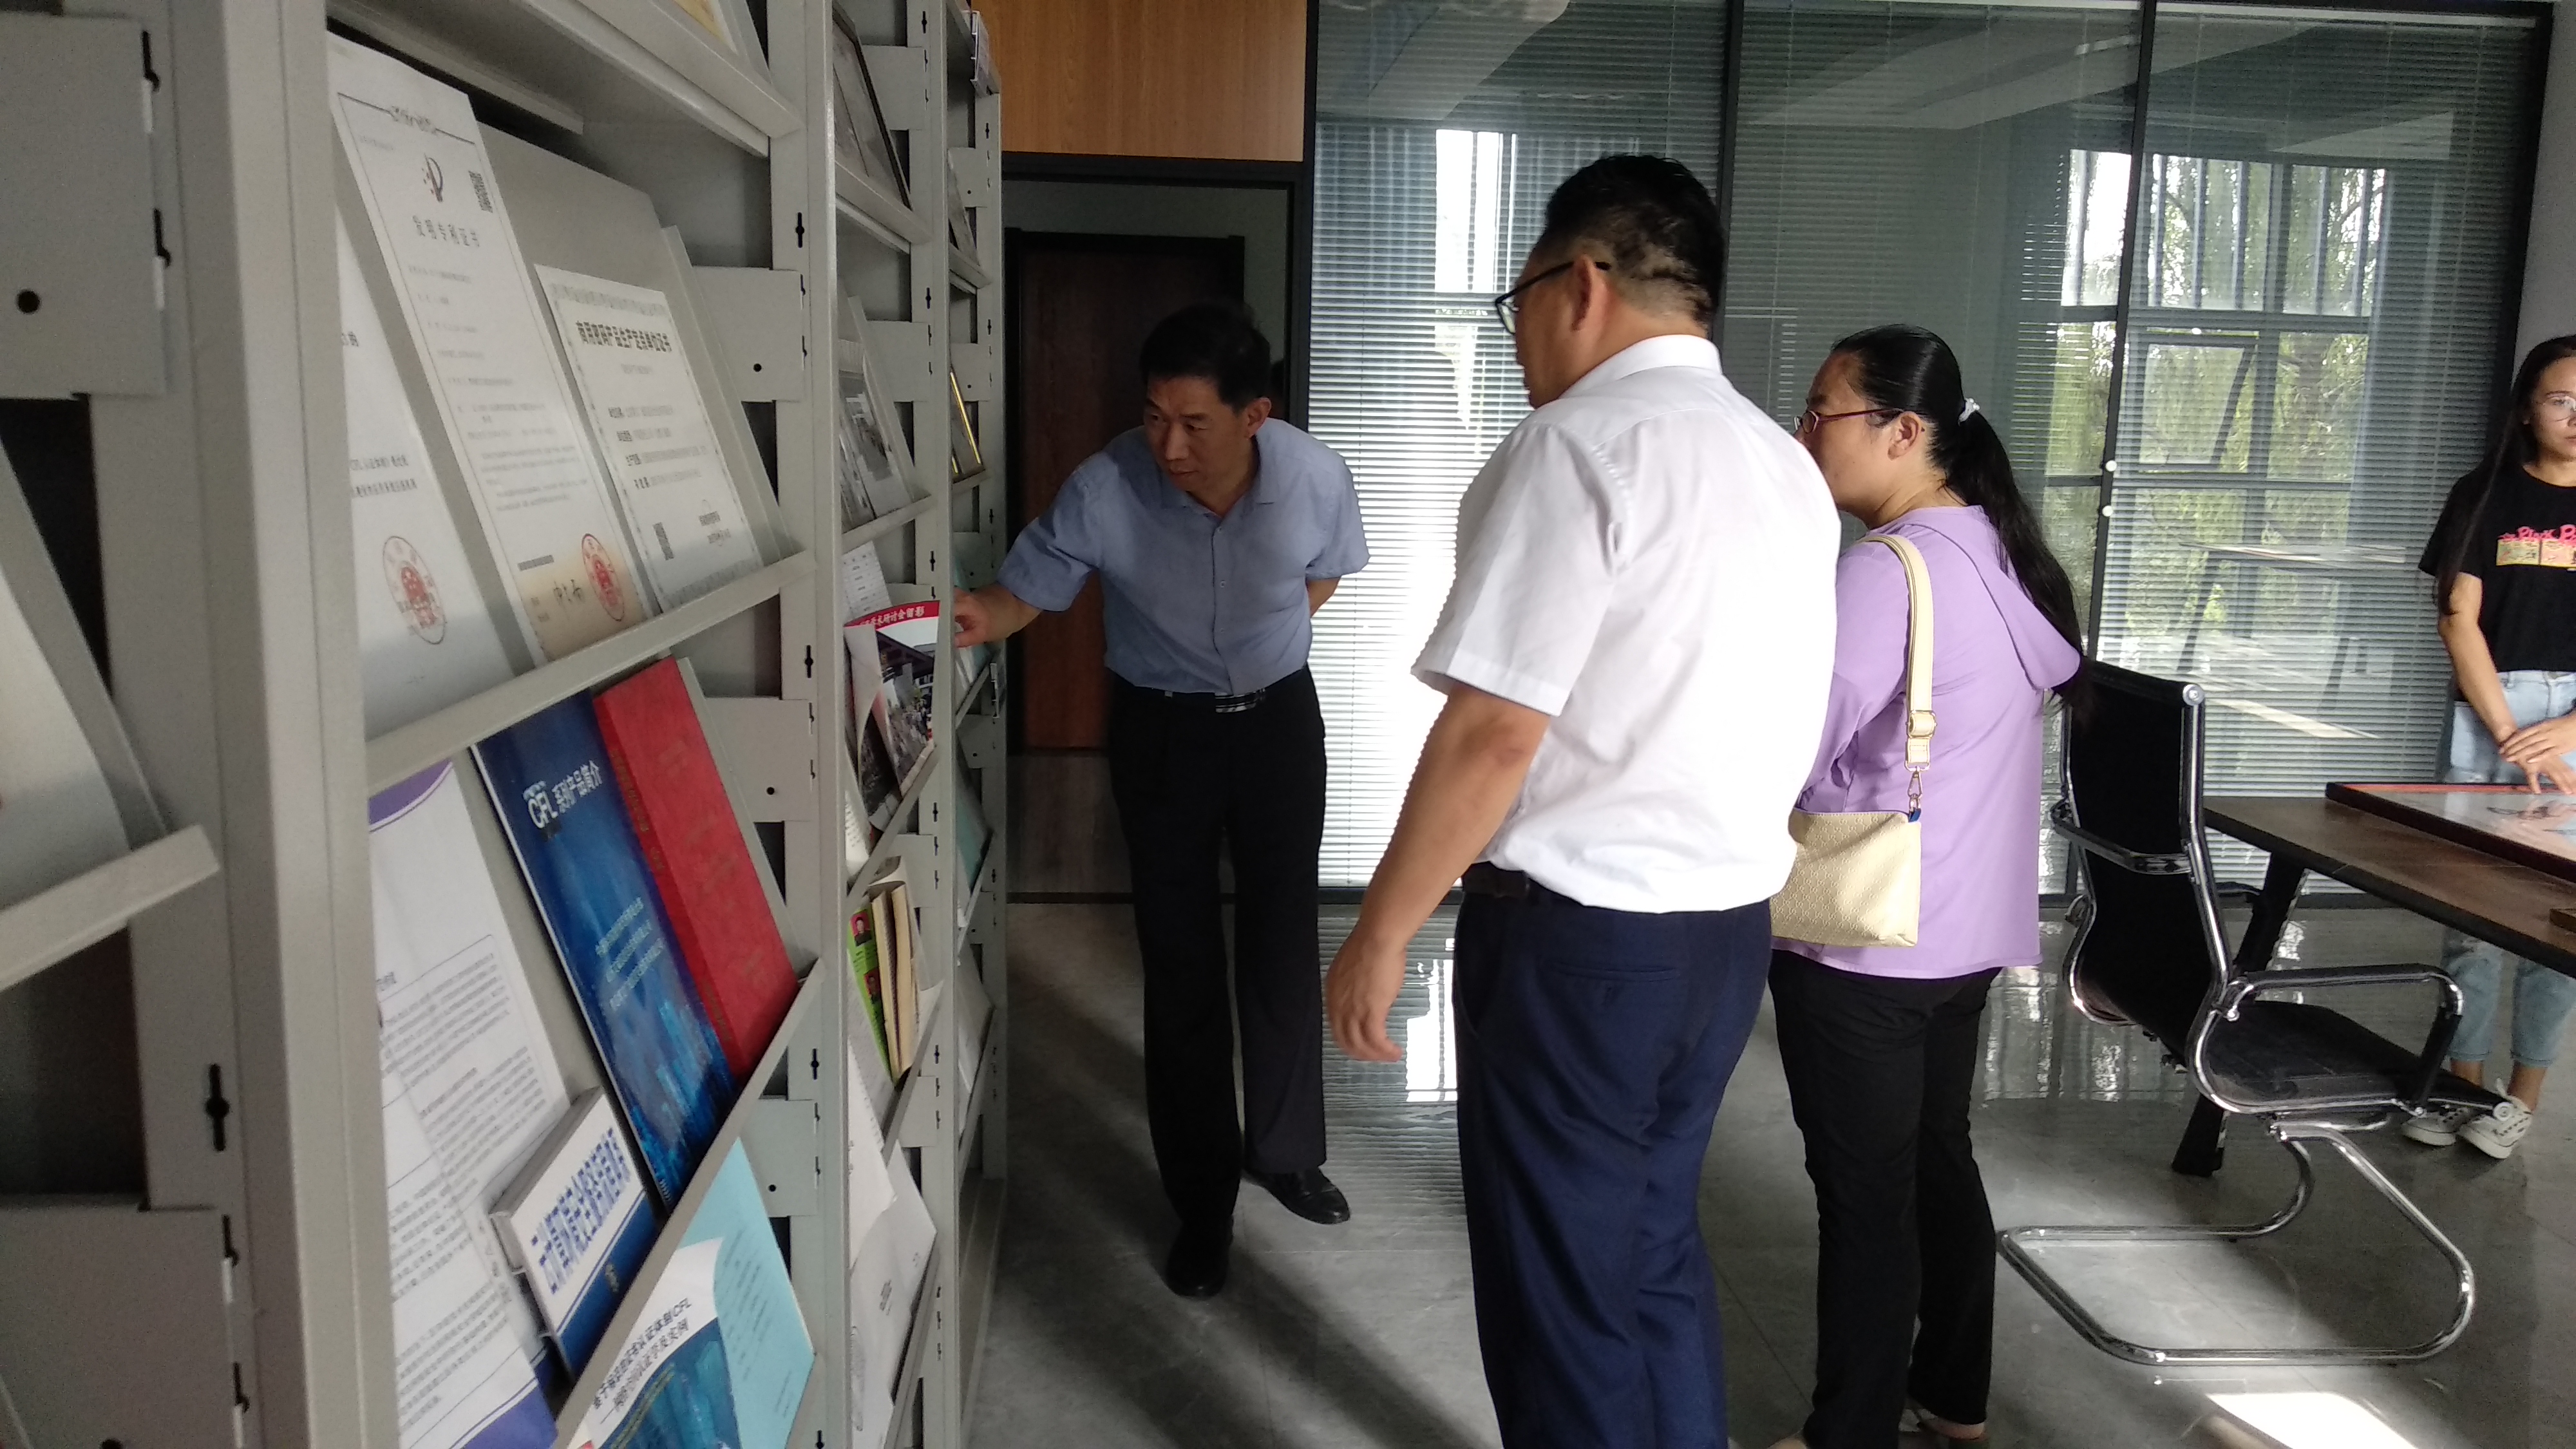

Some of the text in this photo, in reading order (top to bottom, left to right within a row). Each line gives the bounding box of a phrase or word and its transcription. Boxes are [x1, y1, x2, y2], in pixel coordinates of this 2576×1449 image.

[527, 759, 603, 829] CFL 系列产品简介
